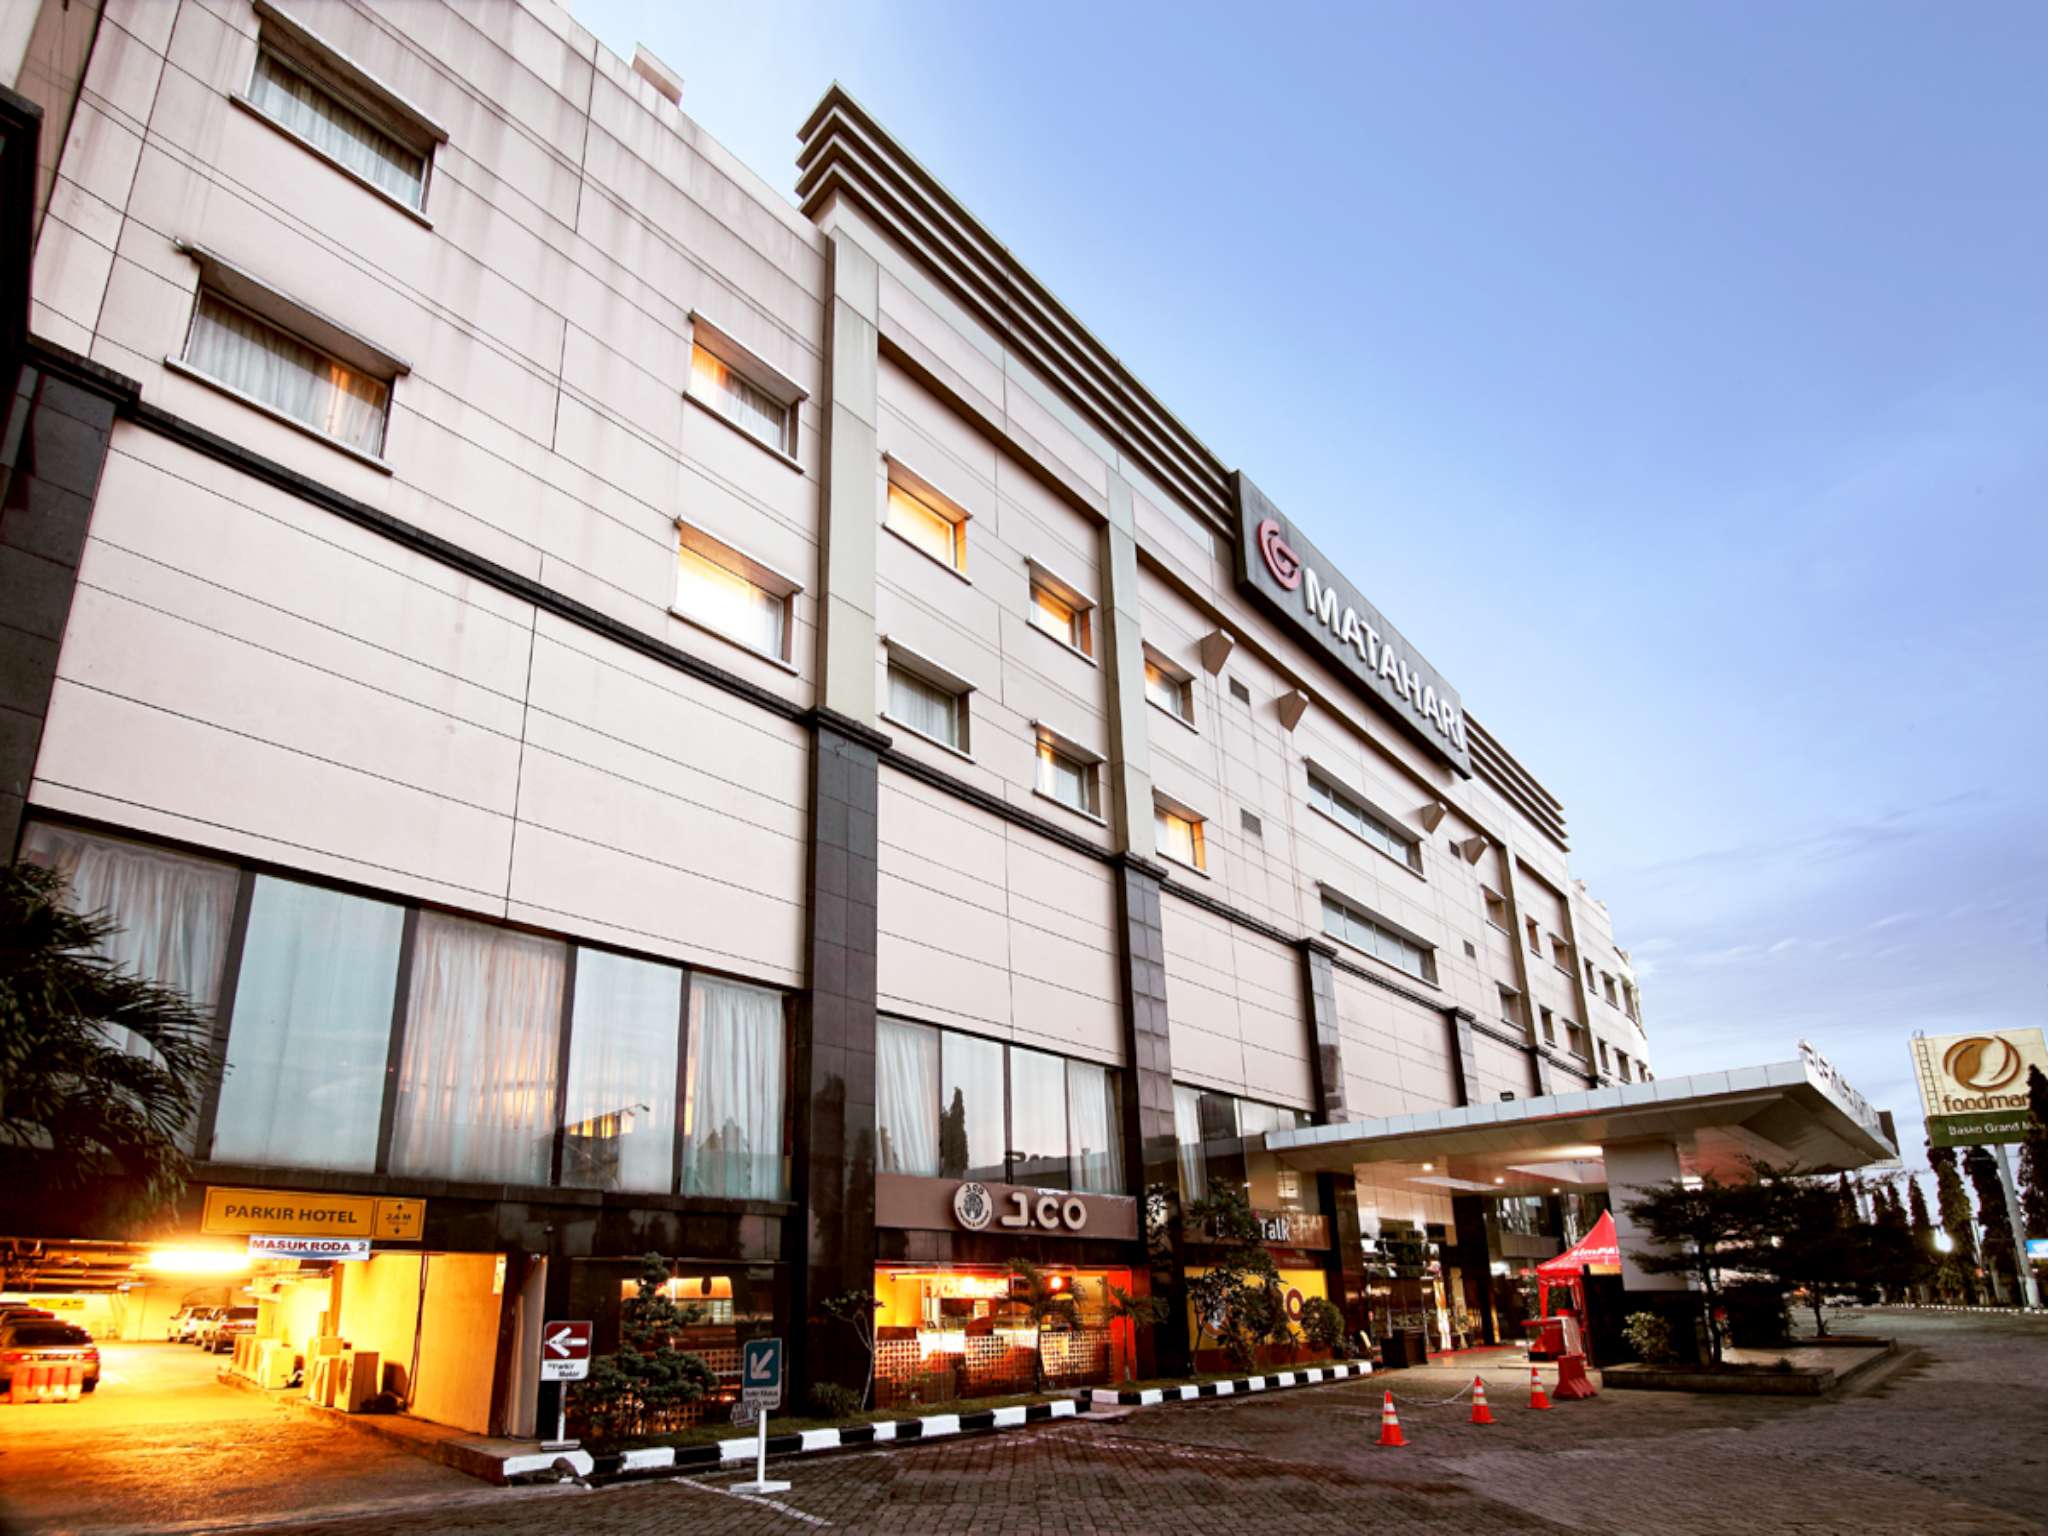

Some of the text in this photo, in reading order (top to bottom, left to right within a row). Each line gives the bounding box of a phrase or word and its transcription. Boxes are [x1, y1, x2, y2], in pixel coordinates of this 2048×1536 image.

[1302, 567, 1466, 752] MATAHARI
[1942, 1092, 2030, 1112] foodmar
[1984, 1121, 2020, 1134] Grand
[224, 1204, 358, 1224] PARKIR HOTEL
[1001, 1191, 1087, 1231] J.CO
[251, 1239, 367, 1252] MASUK RODA 2
